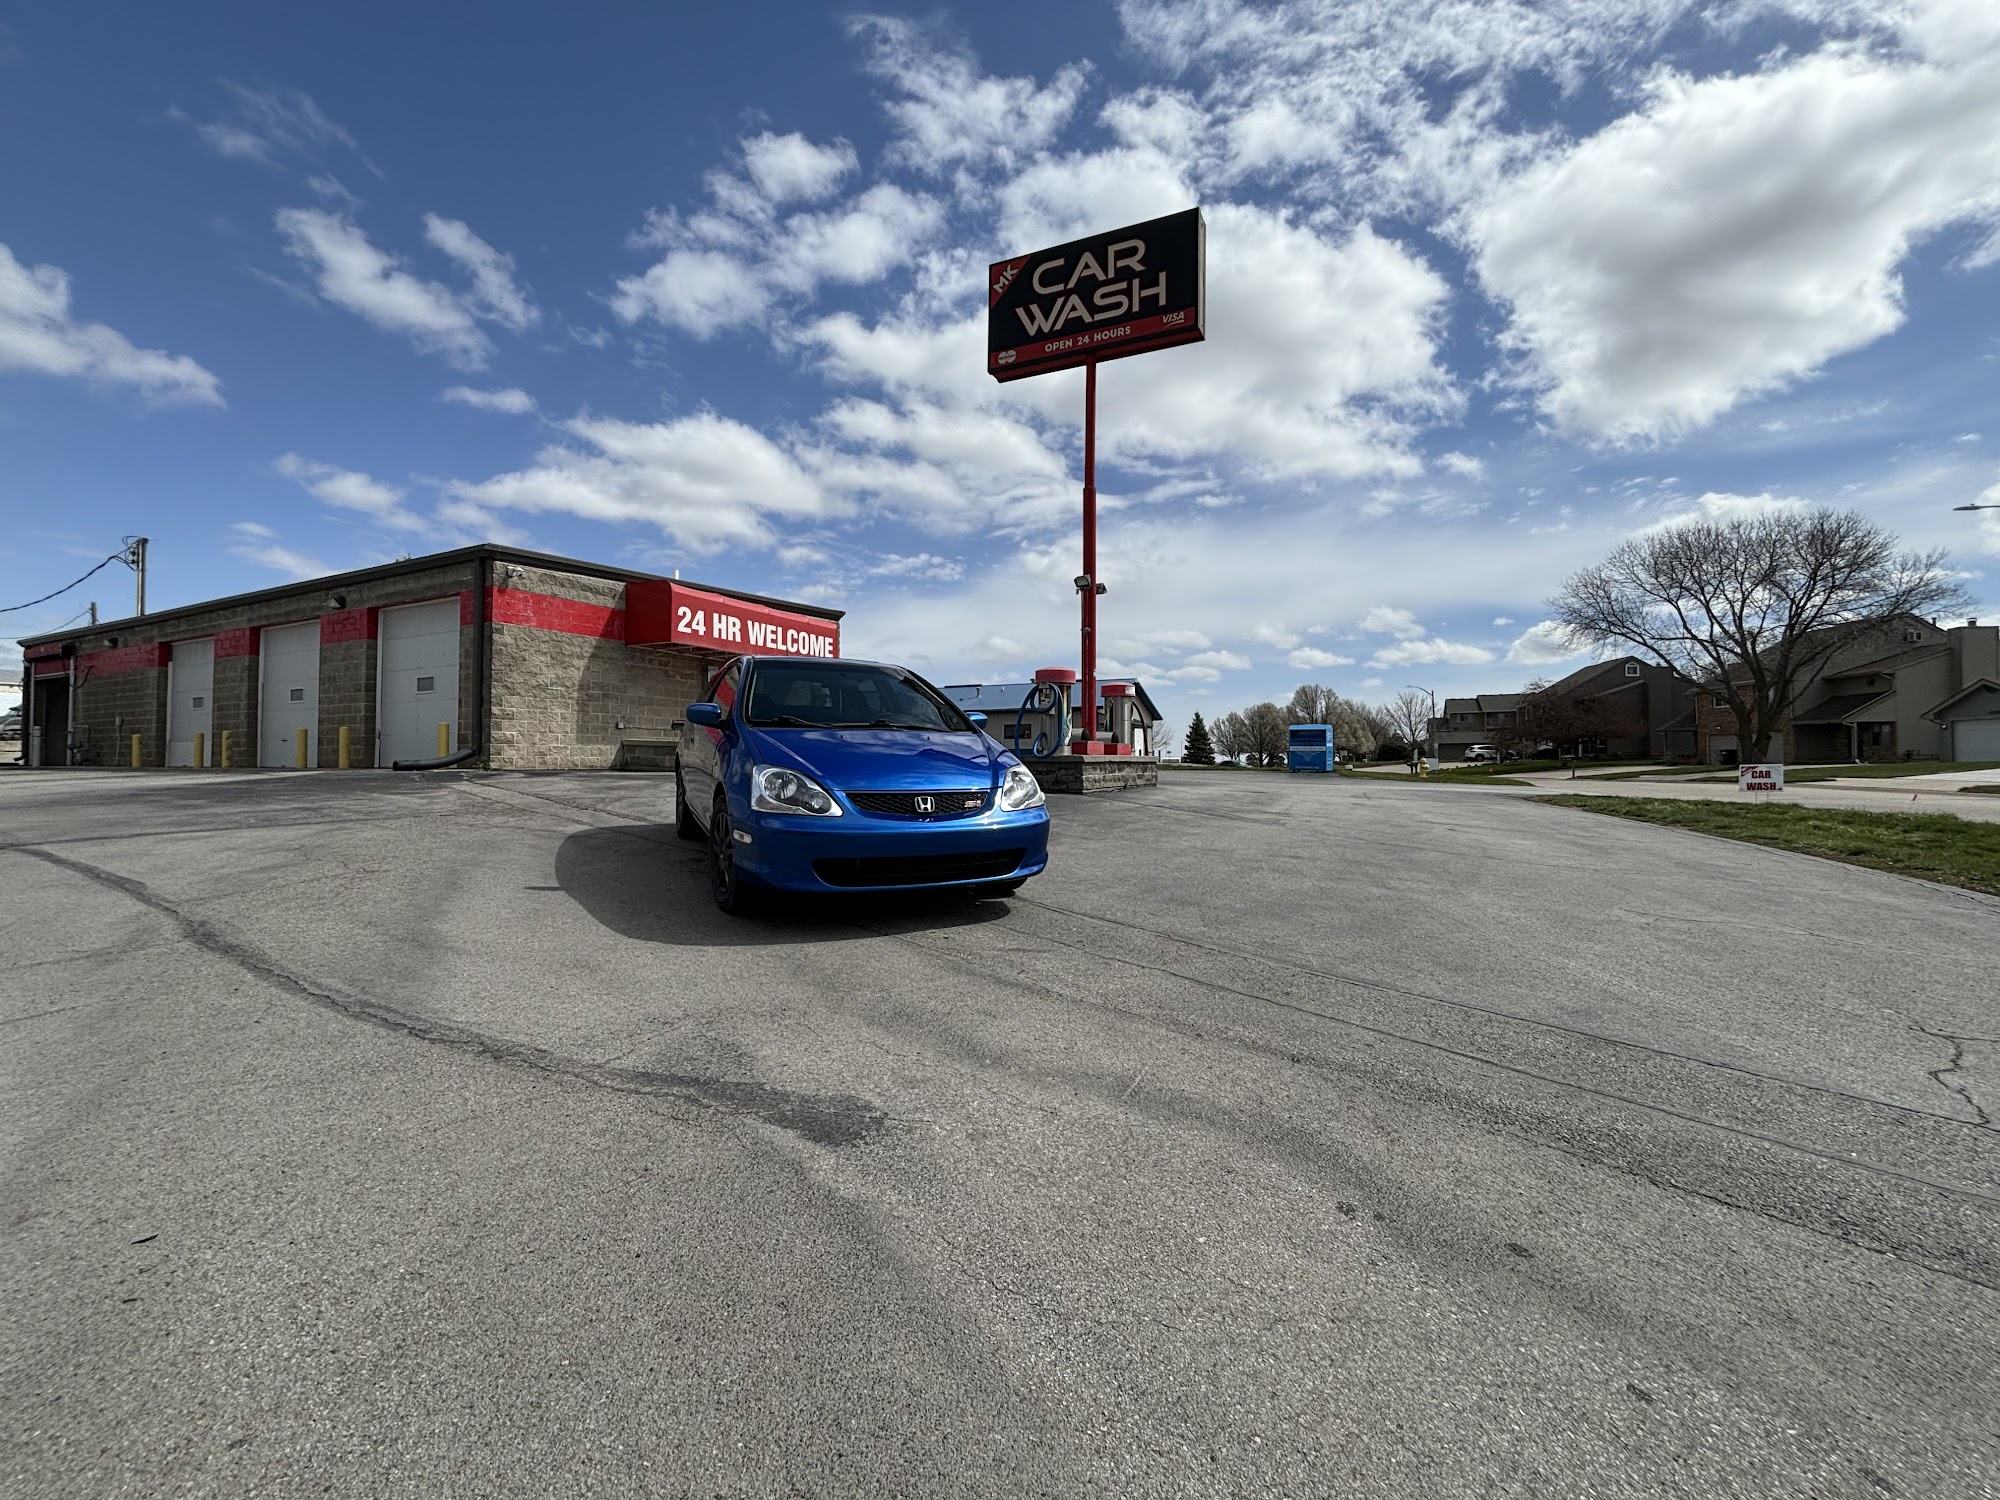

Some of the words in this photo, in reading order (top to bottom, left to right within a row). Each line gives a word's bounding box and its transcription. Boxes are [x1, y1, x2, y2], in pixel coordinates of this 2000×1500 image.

[993, 263, 1019, 293] MK
[1032, 238, 1147, 295] CAR
[1015, 270, 1167, 337] WASH
[1162, 311, 1185, 325] VISA
[1045, 338, 1073, 353] OPEN
[1077, 336, 1090, 346] 24
[1094, 326, 1131, 342] HOURS
[677, 606, 706, 636] 24
[713, 612, 742, 643] HR
[747, 620, 834, 658] WELCOME
[1746, 782, 1776, 791] WASH
[1751, 770, 1771, 779] CAR
